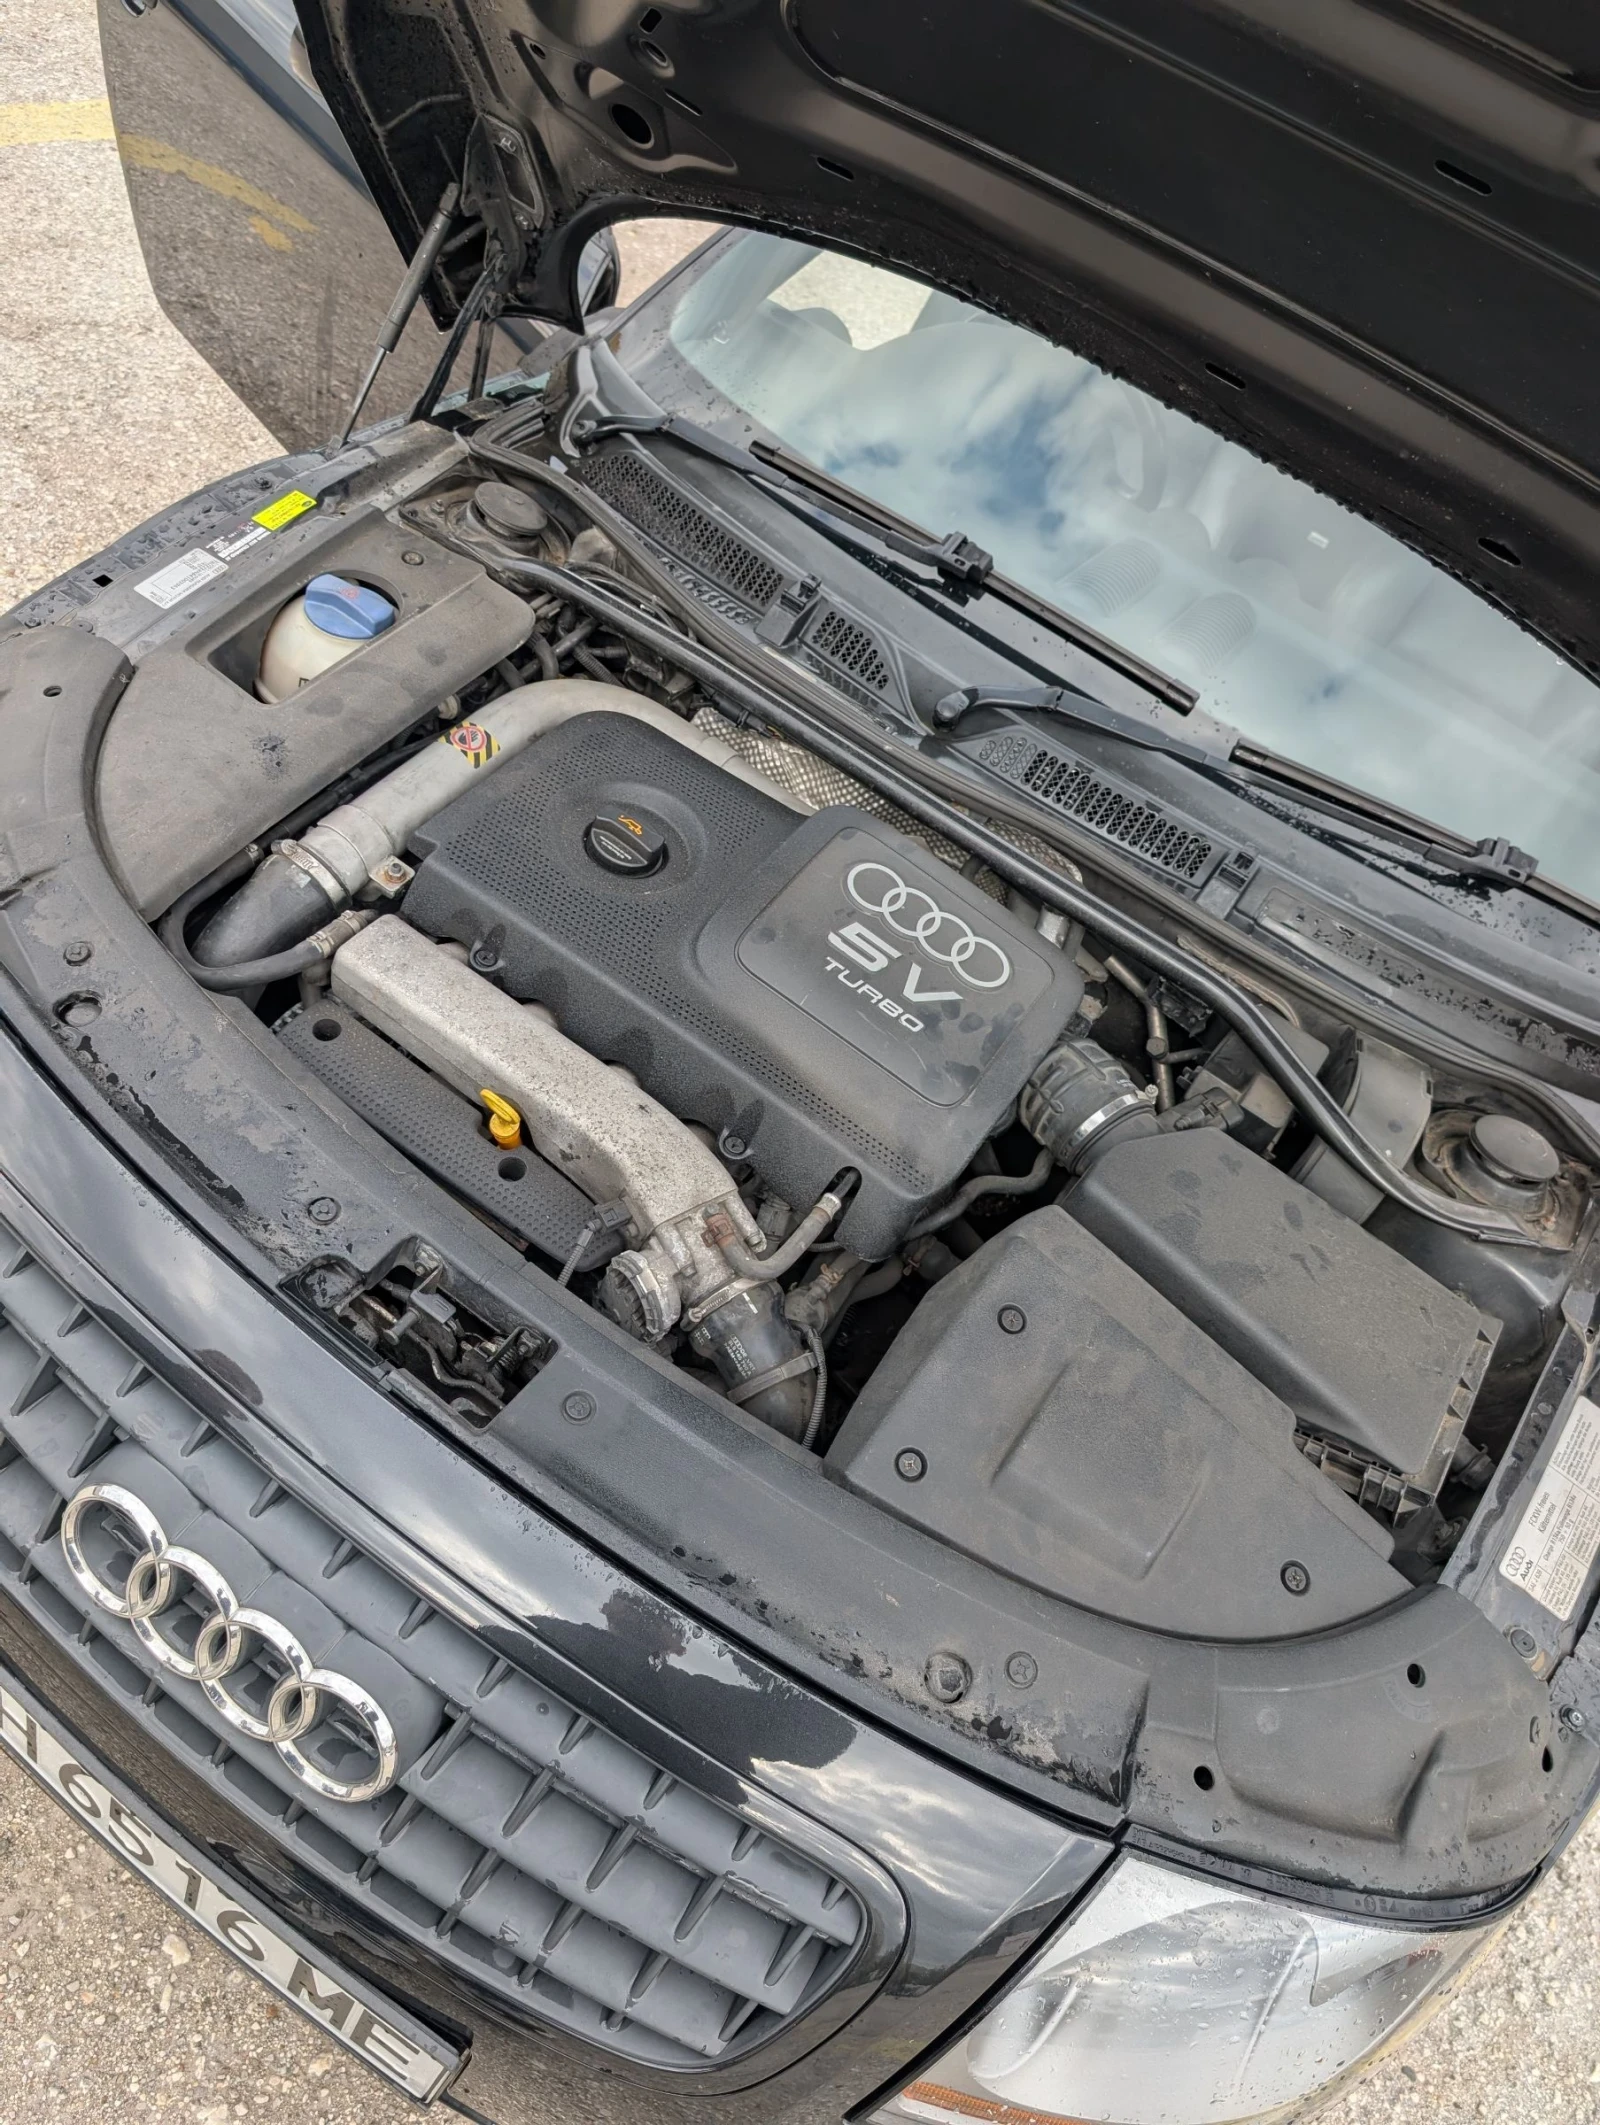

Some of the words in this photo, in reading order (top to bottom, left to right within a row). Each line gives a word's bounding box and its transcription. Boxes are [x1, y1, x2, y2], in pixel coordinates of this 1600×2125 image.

[825, 956, 924, 1032] TURBO
[1518, 1559, 1533, 1581] Audi
[59, 1763, 266, 1962] 6516
[287, 1957, 420, 2081] ME
